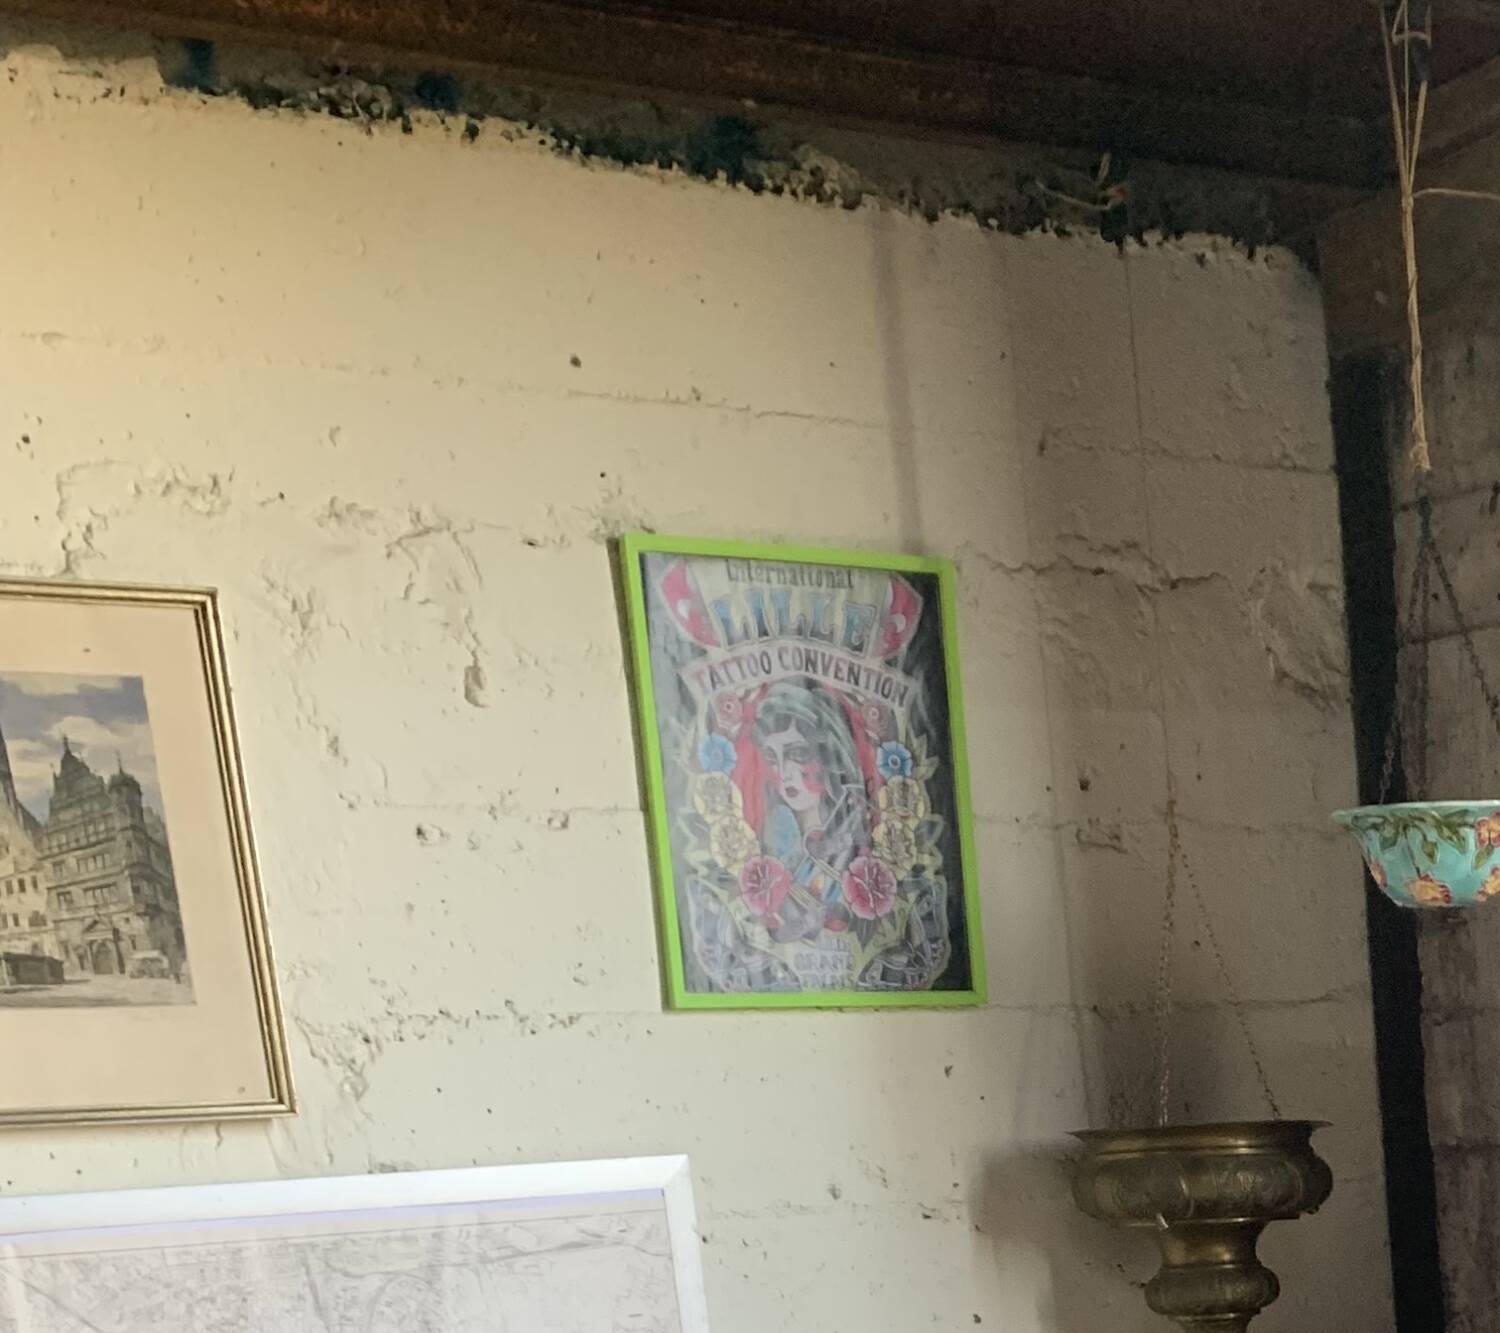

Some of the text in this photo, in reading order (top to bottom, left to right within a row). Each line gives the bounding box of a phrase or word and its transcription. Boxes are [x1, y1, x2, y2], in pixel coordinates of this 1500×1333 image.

[712, 587, 877, 655] LILLE
[691, 645, 910, 706] TATTOO CONVENTION
